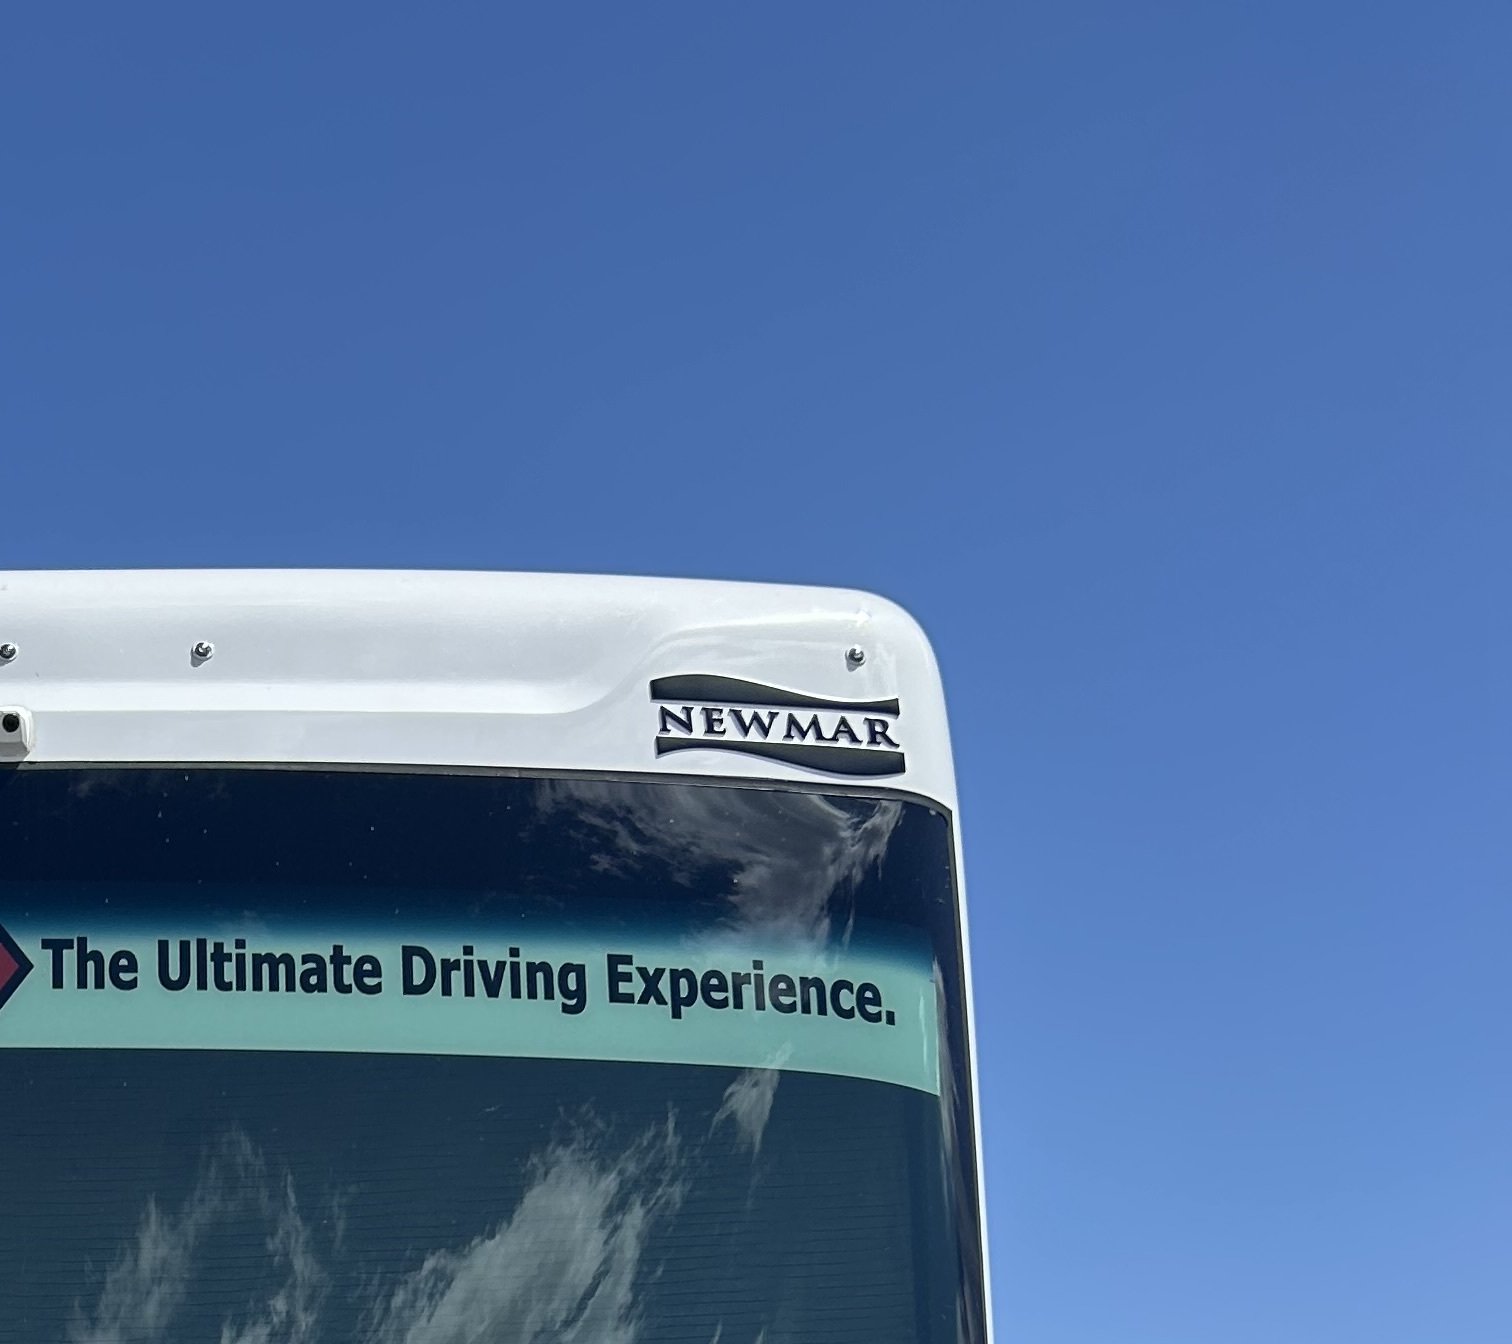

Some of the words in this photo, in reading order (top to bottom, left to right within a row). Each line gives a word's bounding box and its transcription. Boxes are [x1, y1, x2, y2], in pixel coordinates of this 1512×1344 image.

[658, 705, 900, 749] NEWMAR
[41, 936, 138, 991] The
[157, 939, 383, 996] Ultimate
[402, 945, 588, 1014] Driving
[608, 954, 896, 1026] Experience.
